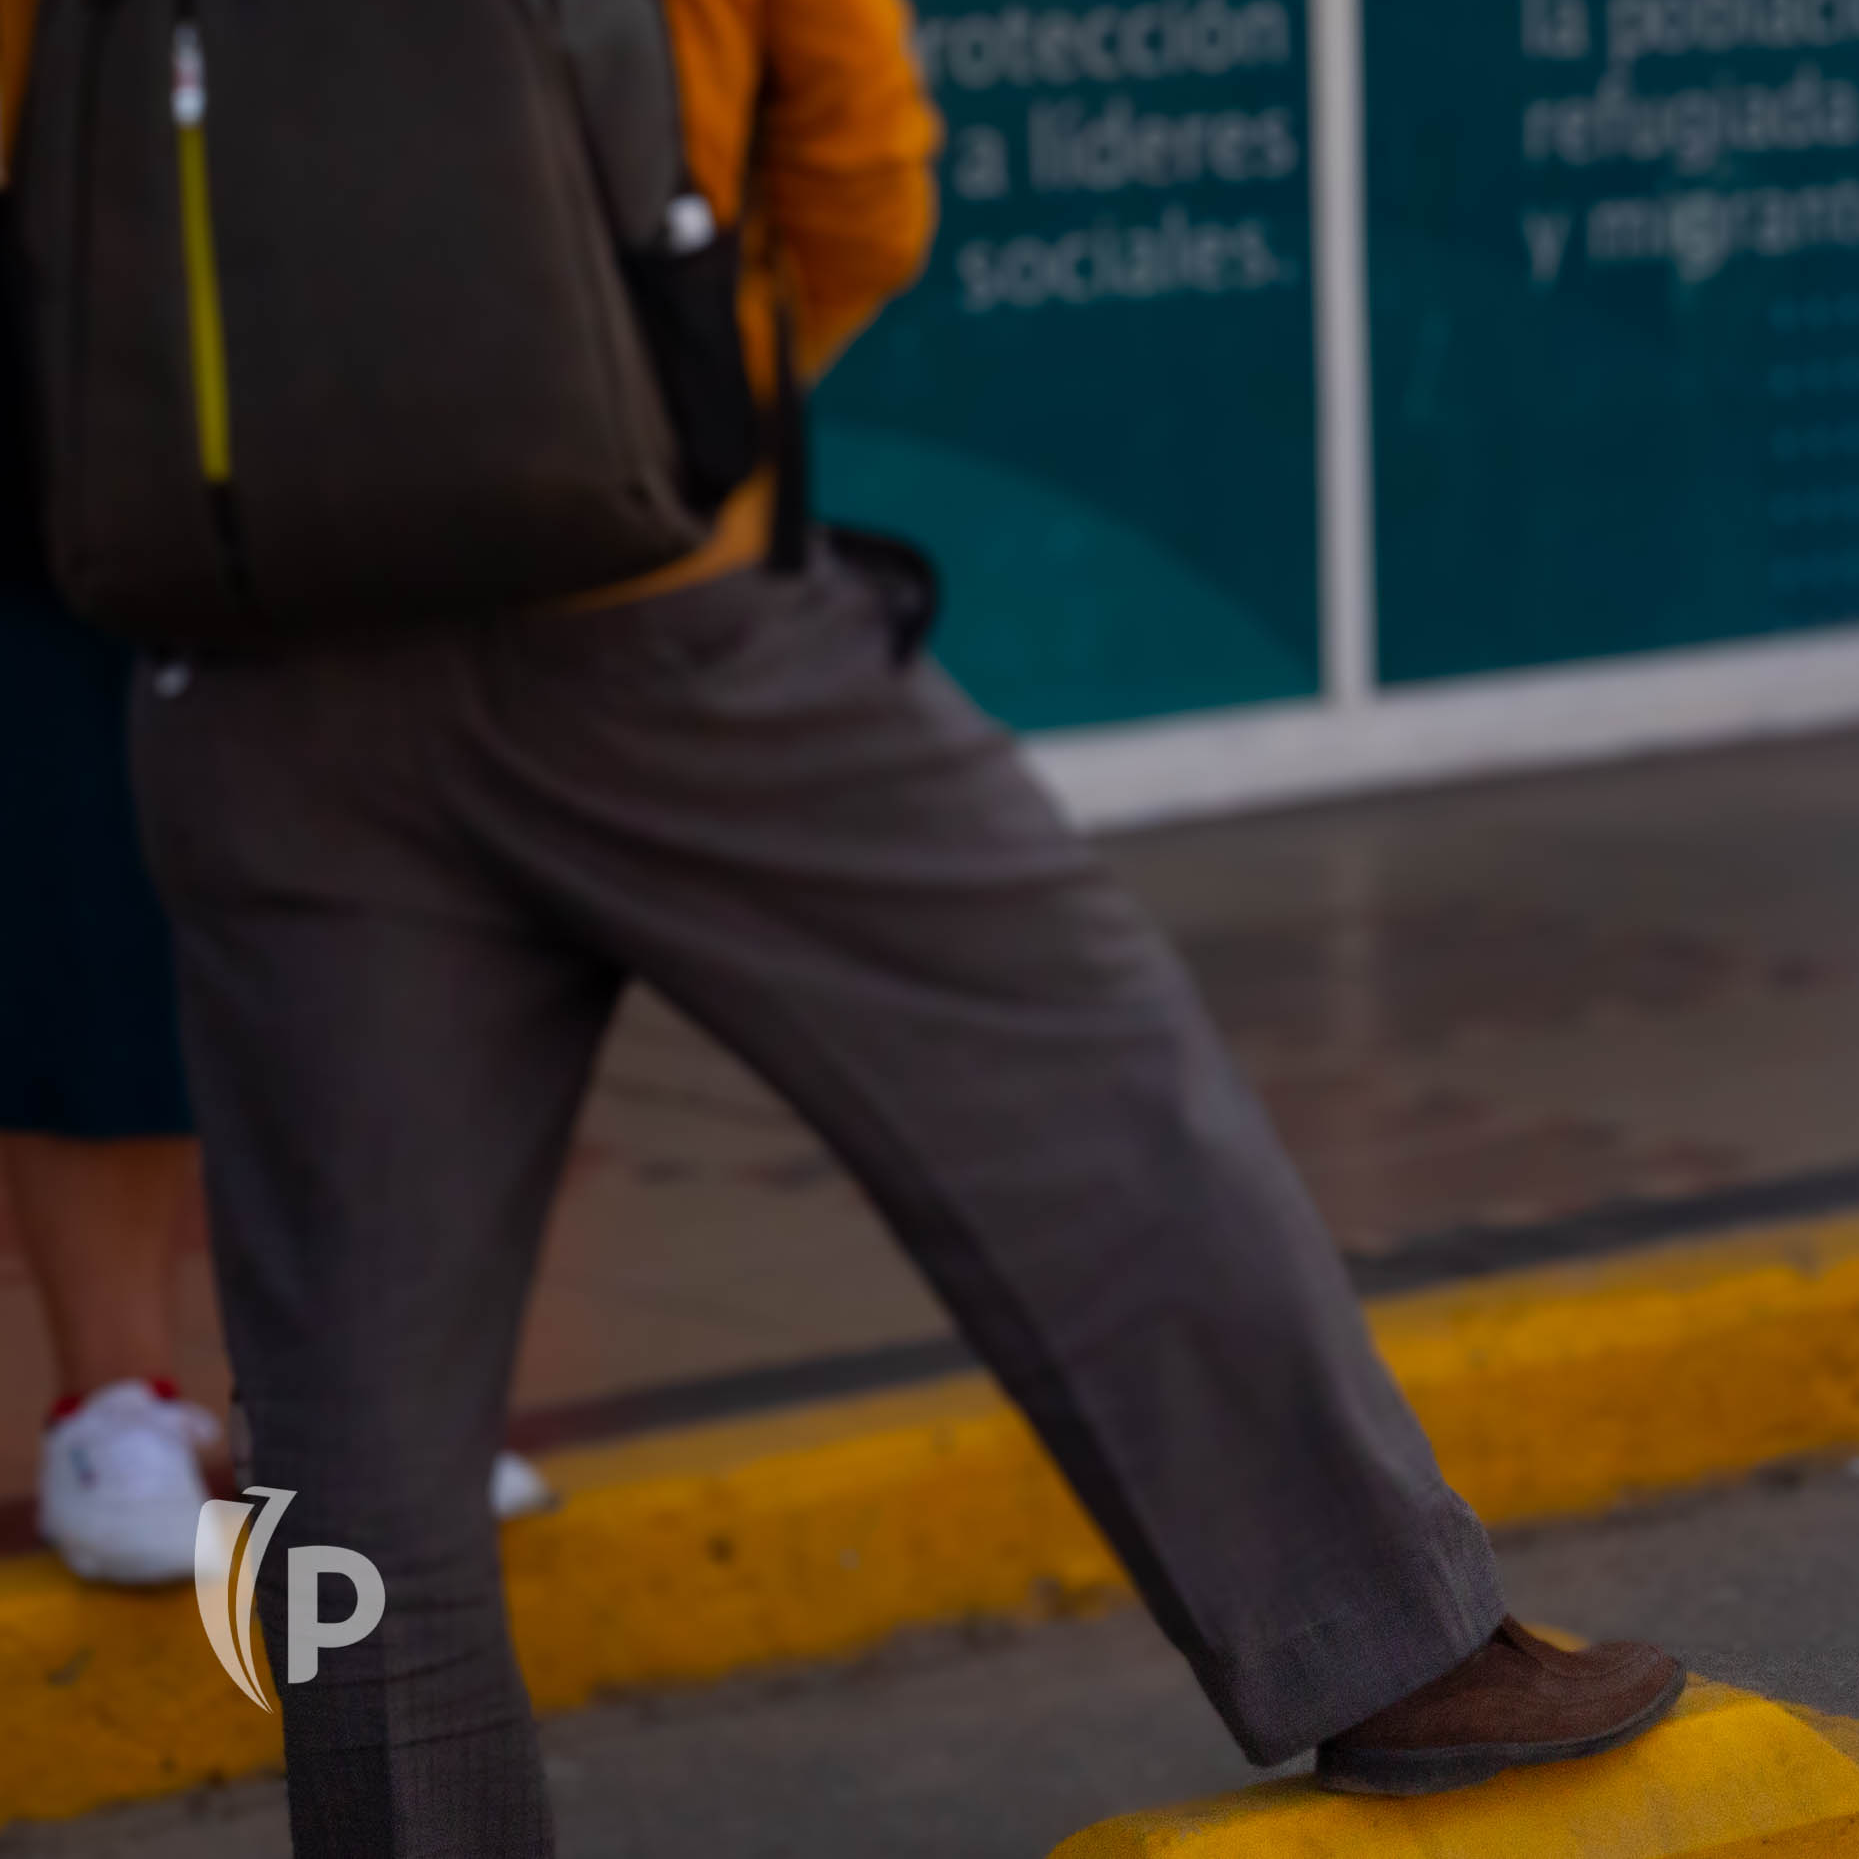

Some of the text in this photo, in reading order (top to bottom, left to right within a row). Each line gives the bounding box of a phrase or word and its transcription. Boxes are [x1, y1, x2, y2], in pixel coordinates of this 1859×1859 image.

[957, 99, 1296, 197] a líderes
[1525, 72, 1859, 167] refugiada
[958, 209, 1297, 310] sociales.
[1525, 211, 1566, 279] y
